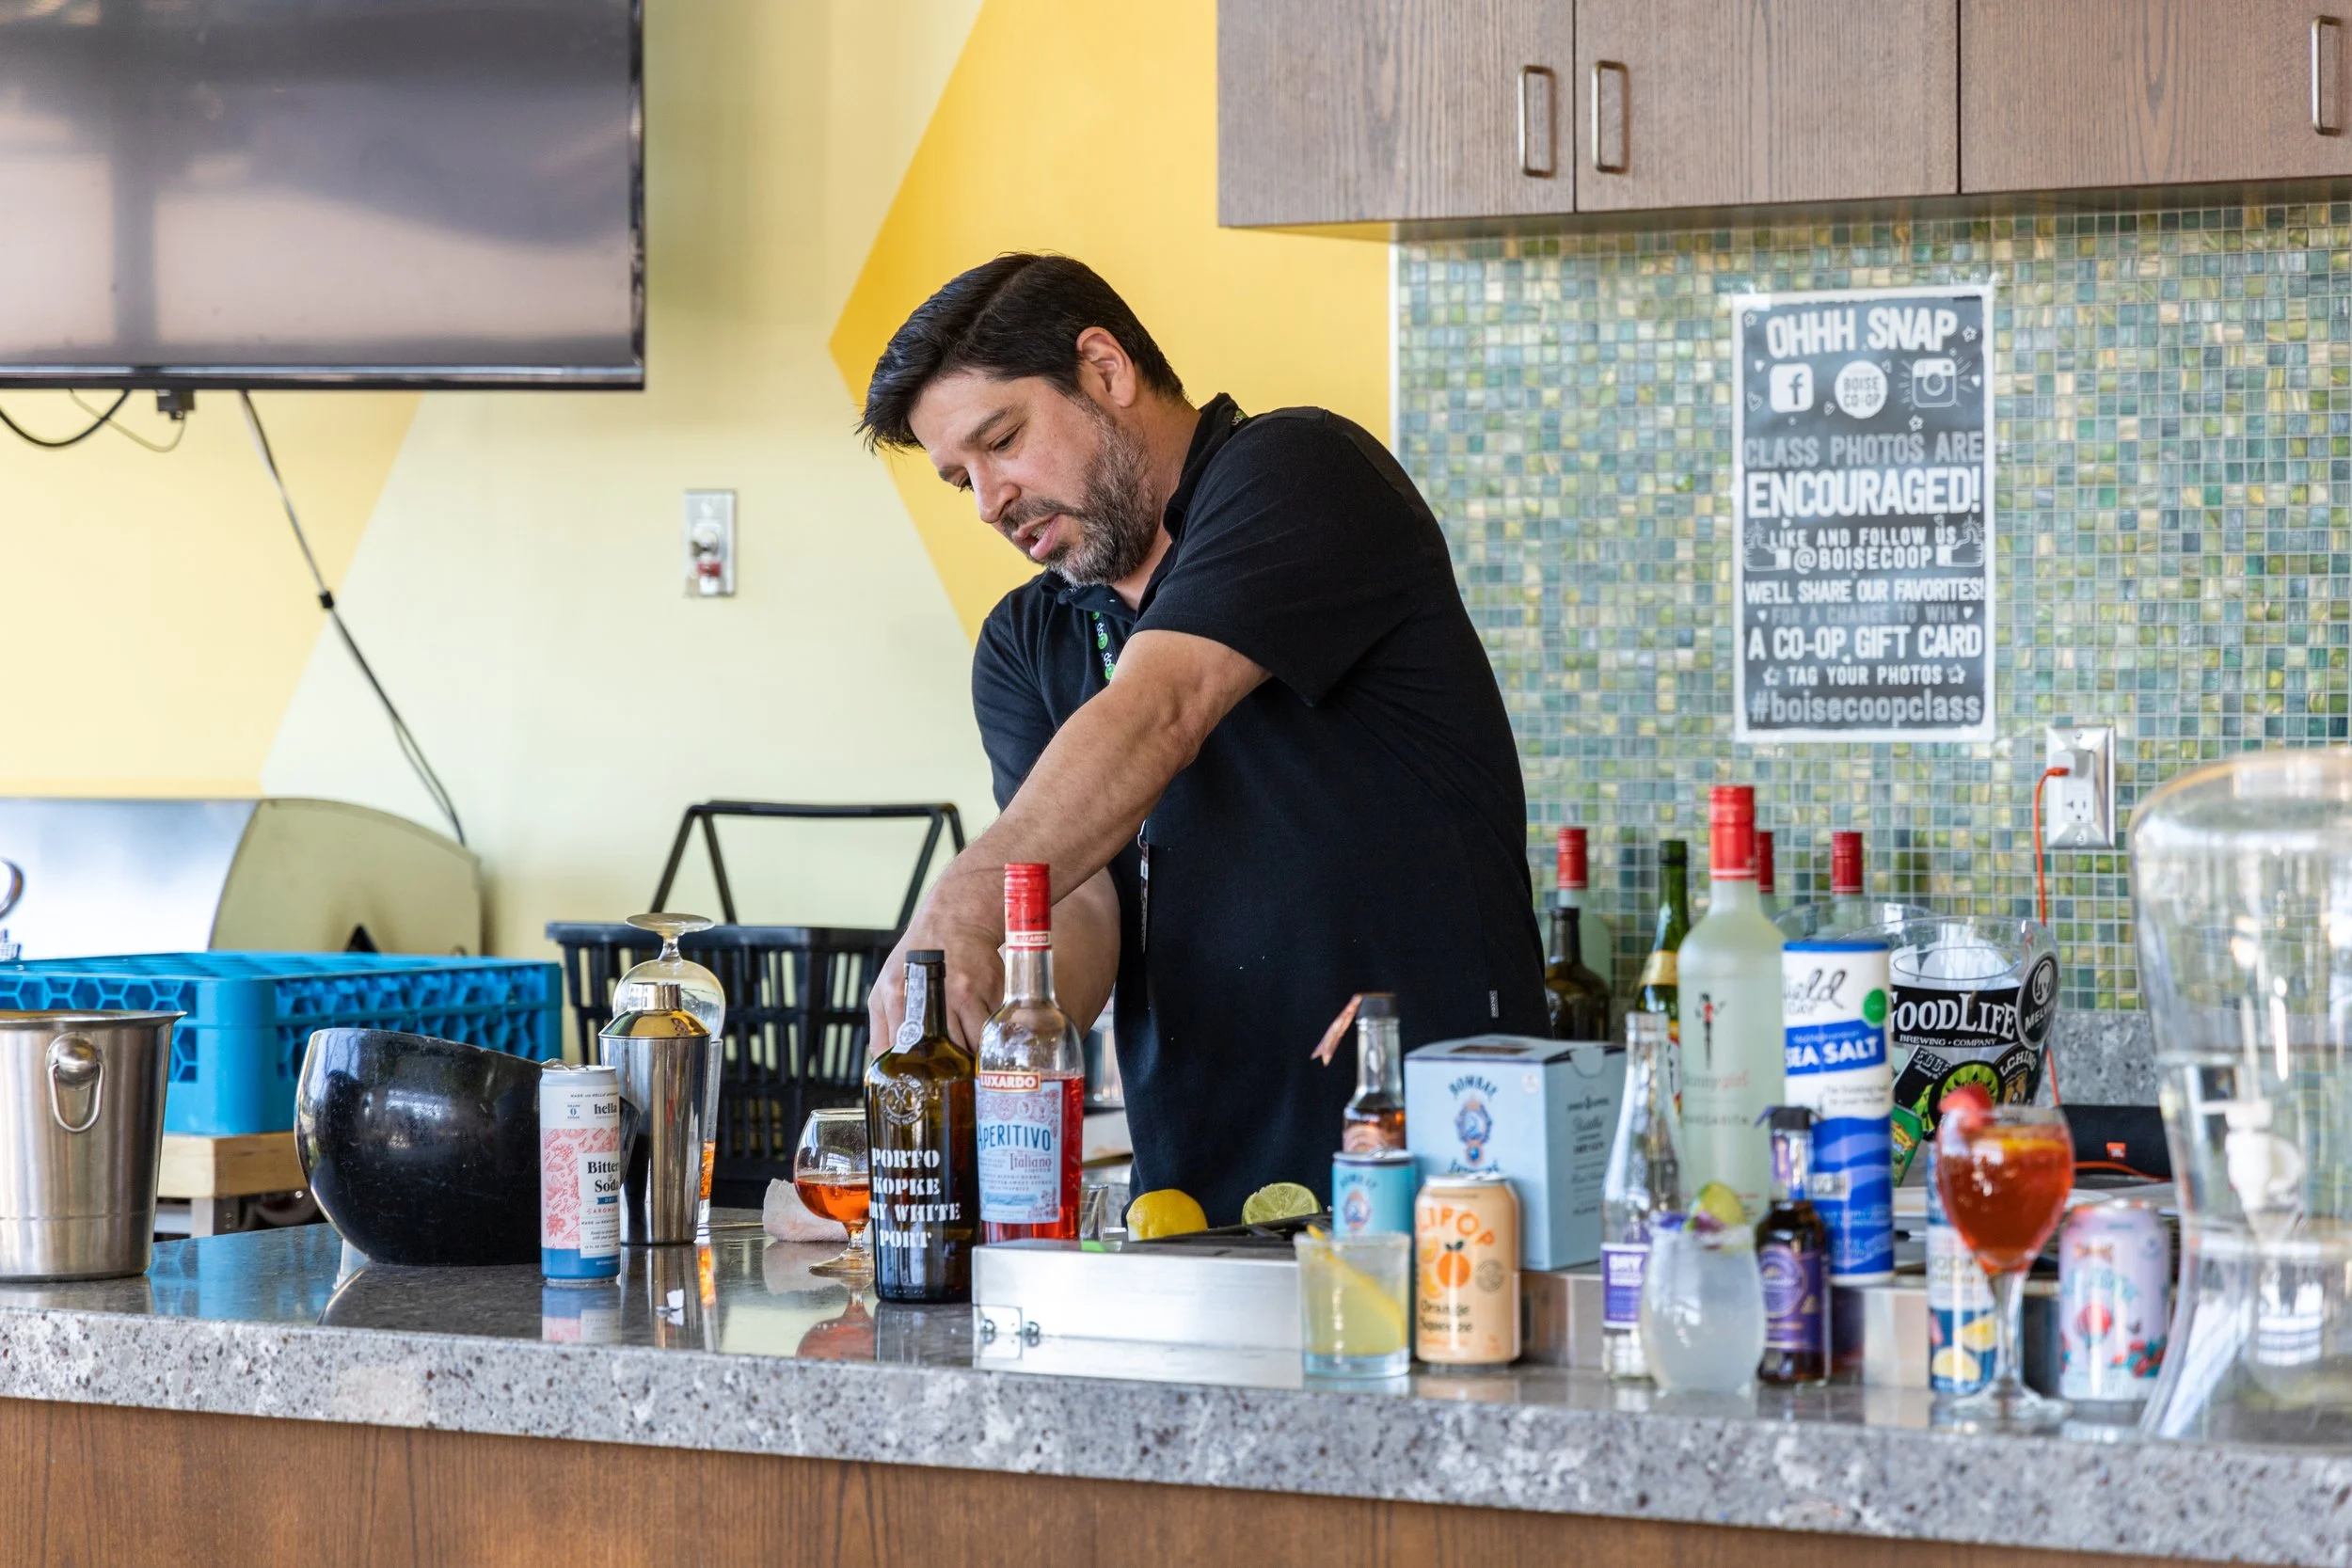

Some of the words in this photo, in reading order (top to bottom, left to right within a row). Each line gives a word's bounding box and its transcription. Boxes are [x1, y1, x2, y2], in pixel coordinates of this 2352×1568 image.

[1766, 308, 1855, 358] OHHH
[1867, 307, 1958, 351] SNAP
[1843, 376, 1879, 391] BOISE
[1743, 435, 1819, 468] CLASS
[1830, 432, 1925, 467] PHOTOS
[1934, 431, 1984, 463] ARE
[1747, 466, 1981, 517] ENCOURAGED!
[1770, 529, 1807, 548] LIKE
[1817, 529, 1851, 547] AND
[1859, 527, 1927, 546] FOLLOW
[1934, 526, 1957, 546] US
[1793, 546, 1933, 575] @BOISECOOP
[1798, 580, 1851, 603] SHARE
[1856, 579, 1889, 602] OUR
[1894, 577, 1985, 602] FAVORITES!
[1771, 607, 1802, 626] FOR
[1808, 607, 1820, 625] A
[1826, 605, 1889, 624] CHANCE
[1898, 605, 1917, 623] TO
[1925, 605, 1958, 623] WIN
[1747, 626, 1767, 660] A
[1772, 626, 1847, 659] CO-OP
[1854, 625, 1912, 658] GIFT
[1918, 625, 1982, 658] CARD
[1788, 667, 1819, 686] TAG
[1826, 666, 1868, 685] YOUR
[1877, 665, 1943, 685] PHOTOS
[1752, 689, 1980, 729] #boisecoopclass
[1899, 1035, 1947, 1046] BREWING
[1953, 1037, 1996, 1047] COMPANY
[1786, 1045, 1820, 1069] SEA
[1822, 1036, 1879, 1065] SALT
[1999, 1051, 2037, 1077] LCHING
[980, 1075, 1037, 1089] LUXARDO
[1449, 1074, 1498, 1101] BOMBAY
[594, 1102, 617, 1115] hella
[978, 1123, 1051, 1151] APERITIVO
[587, 1161, 619, 1174] Bitter
[871, 1148, 940, 1168] PORTO
[1009, 1153, 1052, 1171] Italiano
[873, 1176, 941, 1196] KOPKE
[895, 1202, 961, 1222] WHITE
[1418, 1207, 1495, 1247] LIPOP
[880, 1229, 931, 1248] PORT
